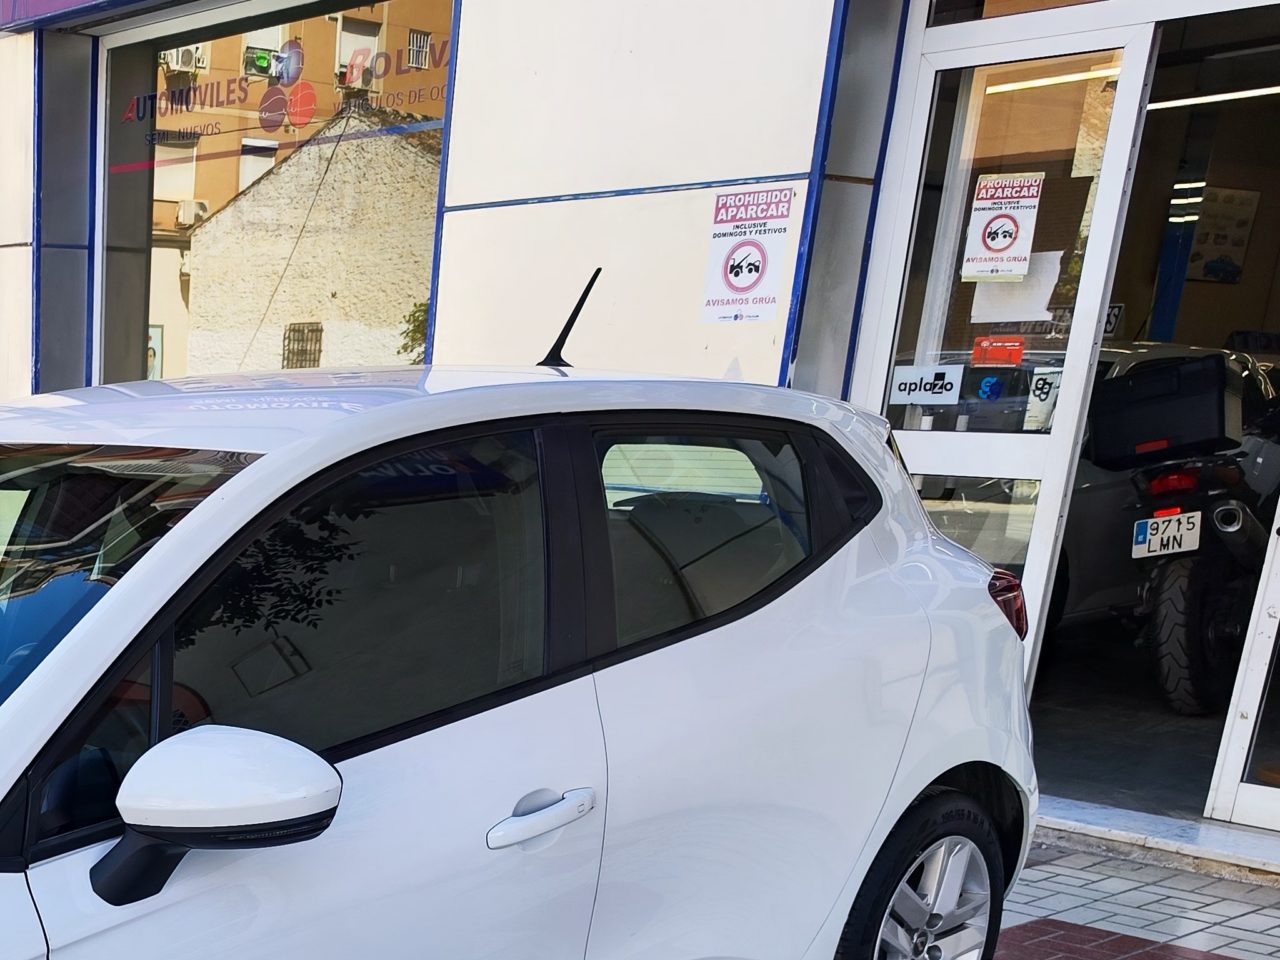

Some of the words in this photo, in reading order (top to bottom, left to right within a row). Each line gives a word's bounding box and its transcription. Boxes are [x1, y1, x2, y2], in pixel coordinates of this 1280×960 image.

[408, 88, 426, 105] DE
[145, 132, 170, 145] SEMI
[178, 121, 221, 141] NUEVOS
[980, 178, 1040, 189] PROHIBIDO
[718, 189, 791, 208] PROHIBIDO
[978, 187, 1038, 199] APARCAR
[716, 202, 789, 221] APARCAR
[712, 231, 747, 239] DOMINGOS
[754, 227, 787, 235] FESTIVOS
[733, 222, 768, 230] INCLUSIVE
[705, 297, 749, 307] AVISAMOS
[898, 376, 954, 396] aplazo
[1149, 516, 1196, 536] 9715
[1147, 534, 1183, 553] LMN
